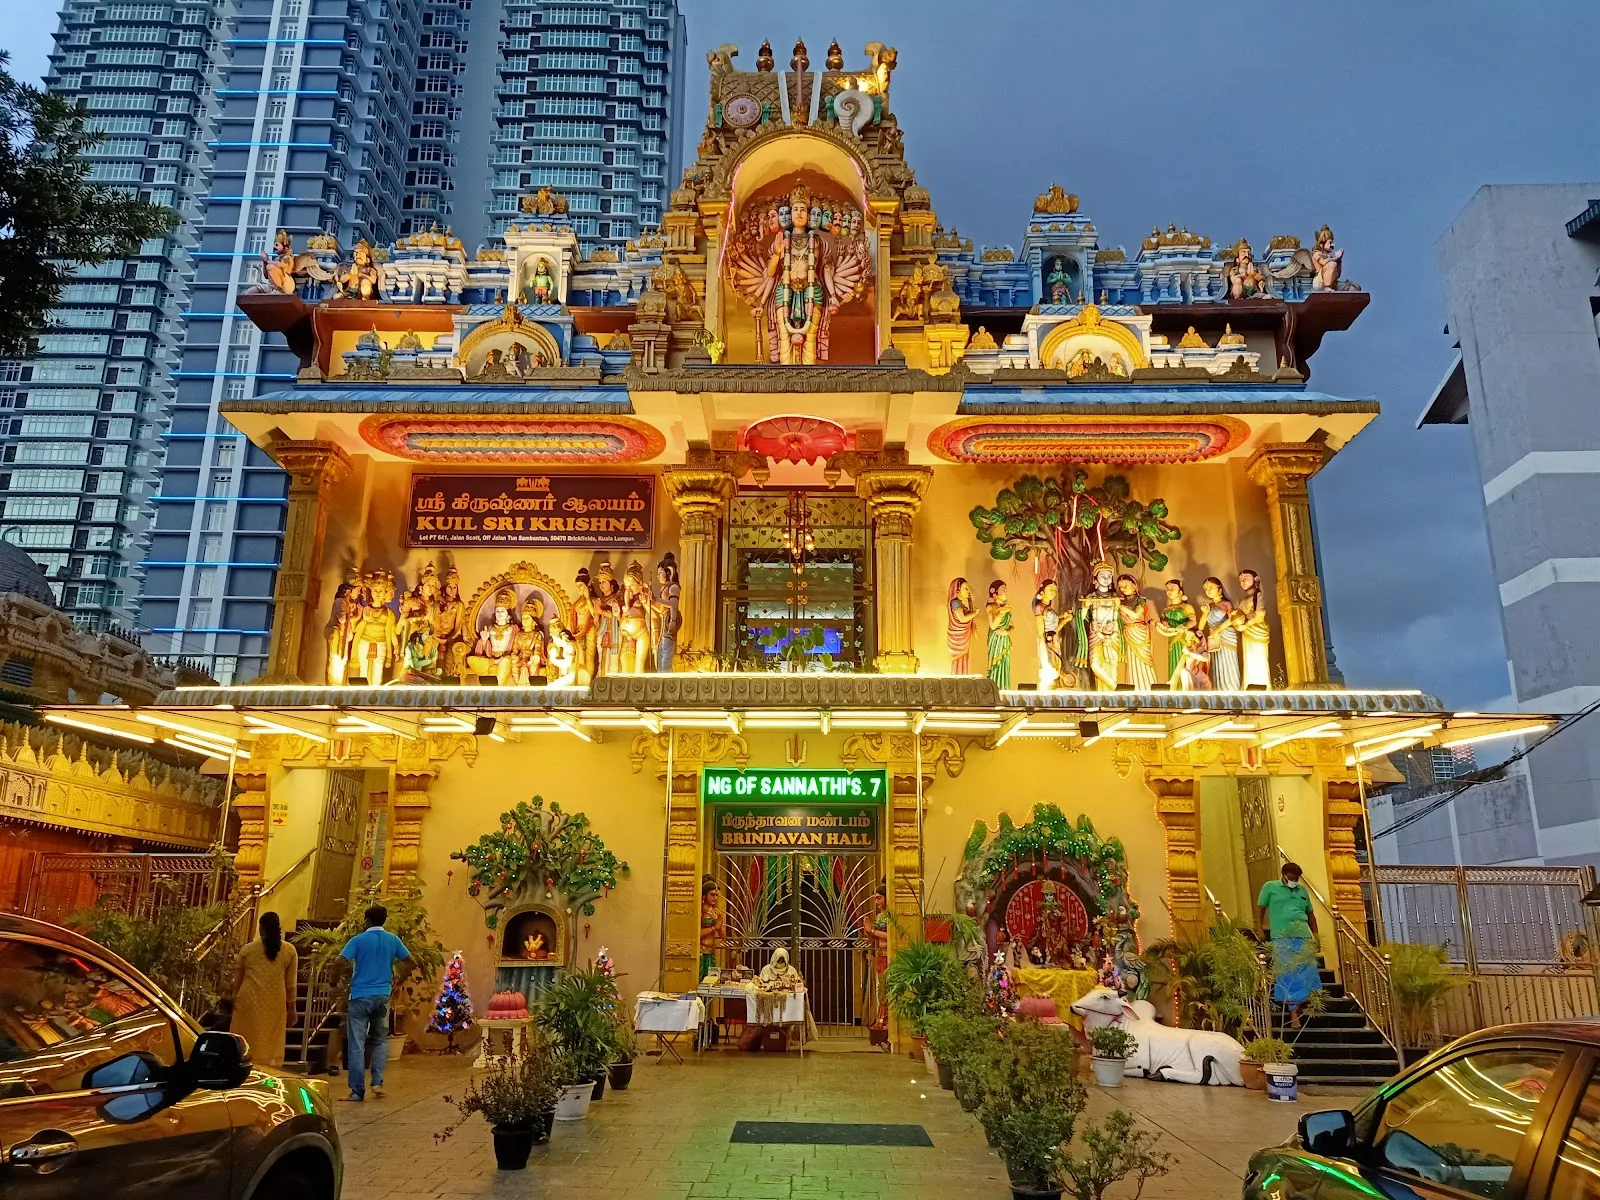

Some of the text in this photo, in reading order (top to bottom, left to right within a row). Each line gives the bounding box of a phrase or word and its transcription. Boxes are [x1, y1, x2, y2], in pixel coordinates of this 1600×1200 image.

[451, 491, 557, 514] கிருஷ்ணர்
[562, 490, 646, 513] ஆலயம்
[416, 516, 645, 532] KUIL SRI KRISHNA
[438, 534, 449, 542] 641,
[466, 534, 482, 542] Scott,
[568, 535, 597, 543] Brickfields,
[708, 776, 881, 797] NG OF SANNATHI'S. 7
[722, 810, 871, 831] பிருந்தாவன மண்டபம்
[722, 832, 872, 845] BRINDAVAN HALL
